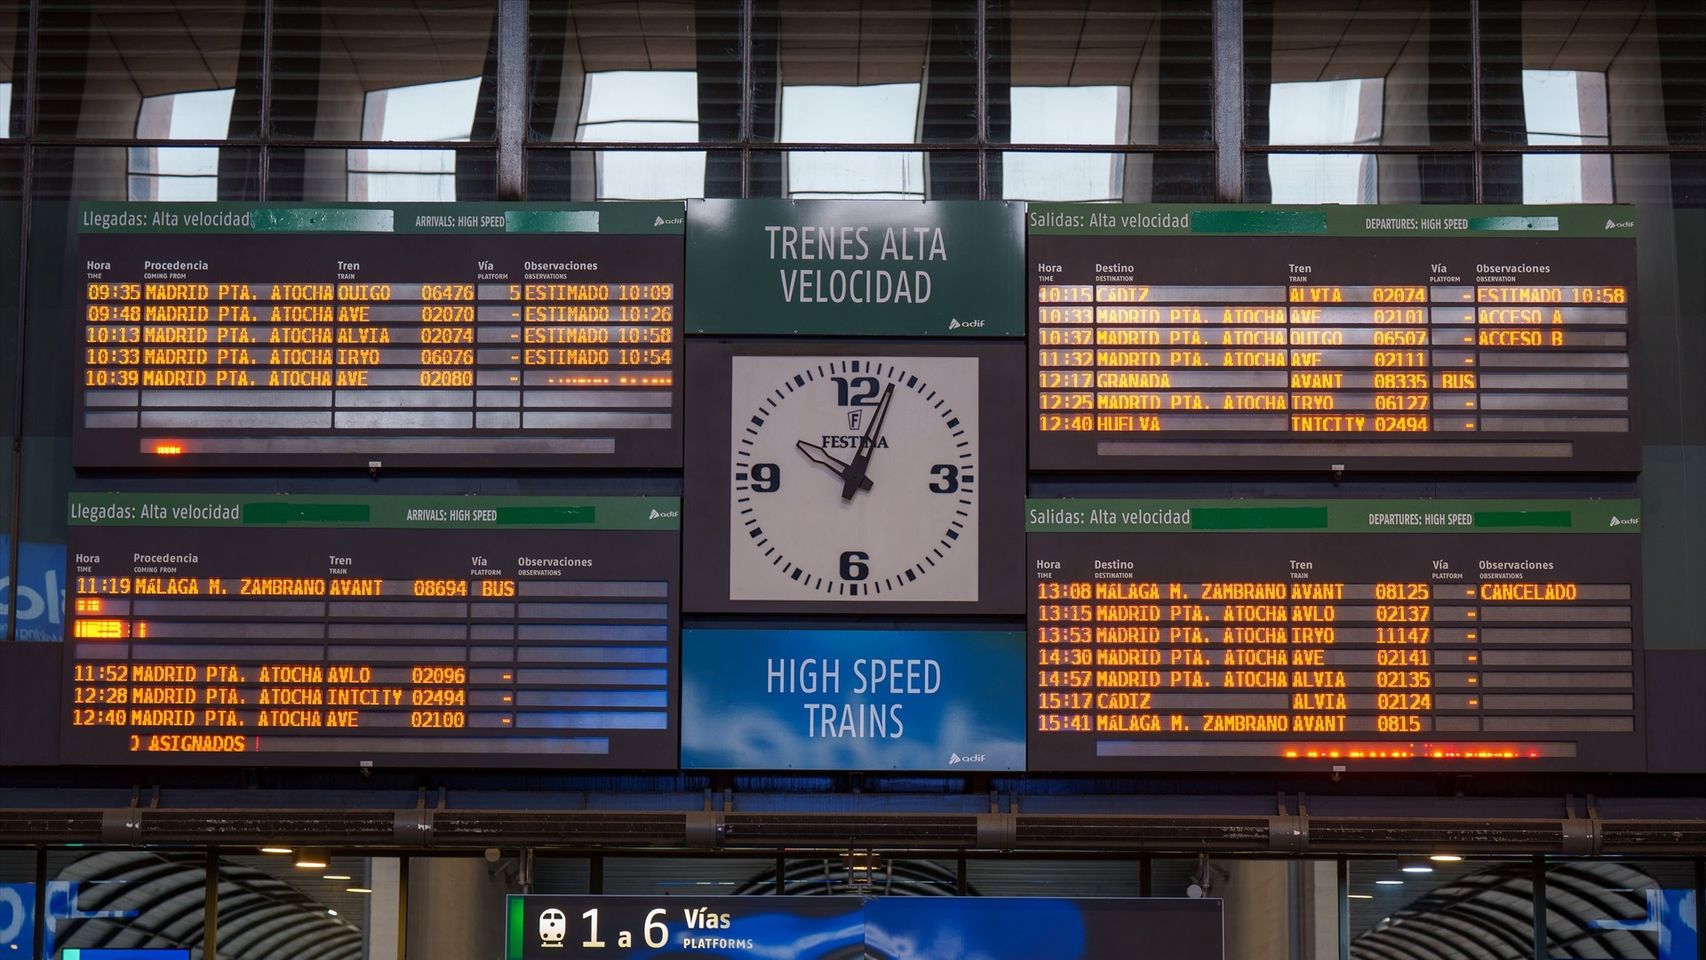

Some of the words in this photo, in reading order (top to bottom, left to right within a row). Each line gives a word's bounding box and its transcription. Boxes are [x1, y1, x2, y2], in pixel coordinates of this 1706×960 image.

[84, 211, 146, 229] Llegadas:
[152, 212, 178, 225] Alta
[184, 212, 252, 226] velocidad
[458, 216, 478, 227] HIGH
[481, 216, 506, 227] SPEED
[1031, 212, 1083, 226] Salidas:
[1090, 213, 1115, 227] Alta
[1122, 213, 1188, 227] velocidad
[1366, 219, 1418, 229] DEPARTURES:
[1421, 219, 1441, 229] HIGH
[1444, 219, 1468, 229] SPEED
[765, 226, 869, 261] TRENES
[881, 227, 947, 262] ALTA
[87, 261, 110, 269] Hora
[144, 260, 208, 270] Procedencia
[338, 262, 359, 270] Tren
[479, 261, 493, 270] Vía
[525, 262, 597, 270] Observaciones
[1039, 264, 1061, 272] Hora
[1096, 264, 1134, 272] Destino
[1289, 264, 1311, 272] Tren
[1432, 264, 1446, 272] Vía
[1477, 264, 1550, 272] Observaciones
[88, 284, 141, 300] 09:35
[146, 285, 208, 300] MADRID
[218, 284, 256, 300] PTA.
[271, 285, 333, 300] ATOCHA
[338, 285, 391, 300] OUIGO
[421, 285, 474, 300] 06476
[509, 285, 521, 300] 5
[525, 285, 609, 300] ESTIMADO
[619, 285, 672, 300] 10:09
[781, 270, 930, 303] VELOCIDAD
[88, 305, 141, 321] 09:48
[145, 306, 208, 321] MADRID
[218, 306, 256, 322] PTA.
[271, 306, 333, 321] ATOCHA
[338, 307, 369, 321] AVE
[422, 306, 474, 322] 02070
[525, 306, 609, 322] ESTIMADO
[619, 306, 672, 322] 10:26
[88, 327, 140, 343] 10:13
[144, 327, 207, 343] MADRID
[217, 327, 256, 343] PTA.
[270, 328, 332, 343] ATOCHA
[337, 328, 390, 343] ALVIA
[421, 328, 473, 343] 02074
[525, 328, 608, 343] ESTIMADO
[619, 328, 672, 343] 10:58
[88, 349, 140, 364] 10:33
[144, 349, 208, 364] MADRID
[217, 349, 255, 364] PTA.
[270, 349, 332, 364] ATOCHA
[338, 349, 380, 364] IRYO
[421, 349, 474, 365] 06076
[525, 349, 609, 364] ESTIMADO
[619, 349, 671, 365] 10:54
[87, 370, 139, 386] 10:39
[143, 370, 206, 386] MADRID
[216, 370, 255, 386] PTA.
[269, 371, 332, 386] ATOCHA
[337, 371, 367, 386] AVE
[420, 371, 473, 386] 02080
[831, 377, 881, 407] 12
[751, 463, 780, 493] 9
[929, 464, 958, 494] 3
[72, 504, 135, 522] Llegadas:
[141, 504, 166, 518] Alta
[173, 504, 238, 519] velocidad
[407, 510, 446, 520] ARRIVALS:
[450, 510, 470, 521] HIGH
[473, 510, 497, 521] SPEED
[1031, 509, 1084, 523] Salidas:
[1090, 510, 1116, 524] Alta
[1122, 509, 1189, 524] velocidad
[1369, 514, 1421, 524] DEPARTURES:
[1425, 514, 1445, 525] HIGH
[1448, 514, 1472, 525] SPEED
[76, 554, 99, 562] Hora
[134, 554, 198, 562] Procedencia
[330, 556, 351, 564] Tren
[472, 556, 487, 565] Vía
[519, 557, 592, 566] Observaciones
[839, 551, 869, 580] 6
[1037, 560, 1060, 568] Hora
[1095, 560, 1133, 569] Destino
[1290, 561, 1312, 569] Tren
[1433, 560, 1448, 569] Vía
[1479, 561, 1553, 569] Observaciones
[78, 578, 130, 594] 11:19
[208, 579, 226, 594] M.
[240, 579, 325, 595] ZAMBRANO
[330, 580, 382, 595] AVANT
[414, 580, 467, 596] 08694
[482, 581, 514, 596] BUS
[1039, 583, 1092, 599] 13:08
[1169, 584, 1188, 599] M.
[1202, 583, 1287, 599] ZAMBRANO
[1291, 584, 1343, 599] AVANT
[1375, 584, 1429, 600] 08125
[1481, 584, 1577, 600] CANCELADO
[1040, 605, 1092, 621] 13:15
[1096, 605, 1160, 621] MADRID
[1170, 605, 1210, 621] PTA.
[1223, 605, 1287, 621] ATOCHA
[1292, 606, 1335, 621] AVLO
[1376, 606, 1429, 622] 02137
[768, 659, 839, 693] HIGH
[854, 659, 940, 693] SPEED
[75, 687, 127, 703] 12:28
[132, 688, 196, 704] MADRID
[206, 687, 245, 704] PTA.
[259, 688, 322, 704] ATOCHA
[328, 688, 402, 705] INTCITY
[412, 689, 464, 705] 02494
[804, 704, 903, 738] TRAINS
[148, 735, 246, 751] ASIGNADOS
[583, 909, 605, 947] 1
[618, 931, 631, 947] a
[645, 909, 668, 948] 6
[684, 907, 730, 928] Vías
[684, 938, 753, 949] PLATFORMS
